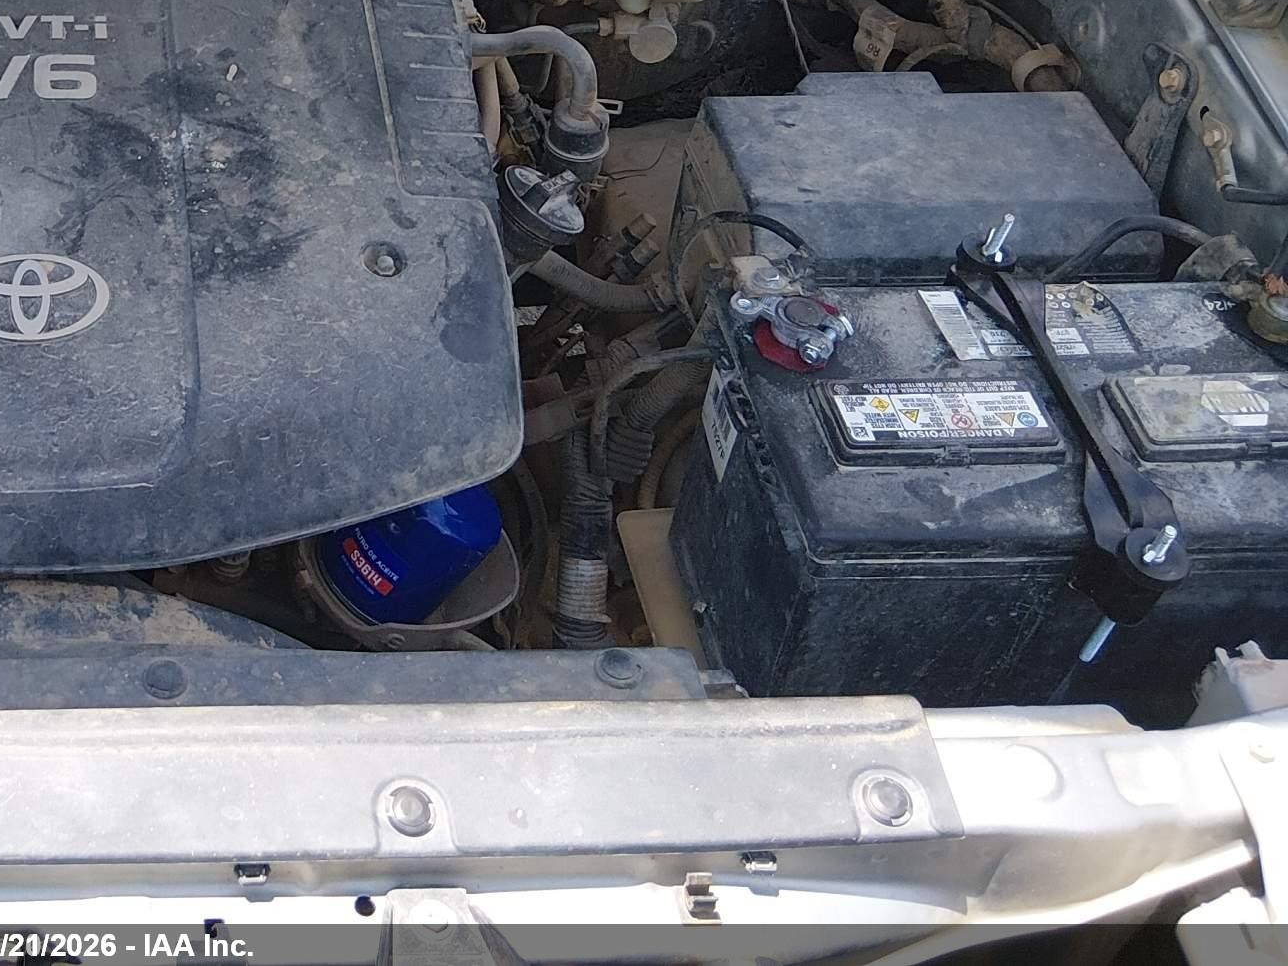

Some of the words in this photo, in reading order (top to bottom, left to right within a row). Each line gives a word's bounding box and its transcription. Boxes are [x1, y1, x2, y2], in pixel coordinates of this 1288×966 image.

[897, 429, 1002, 439] DANGER/POISON
[350, 549, 383, 587] S3614
[367, 549, 378, 561] DE
[375, 560, 400, 582] ACEITE
